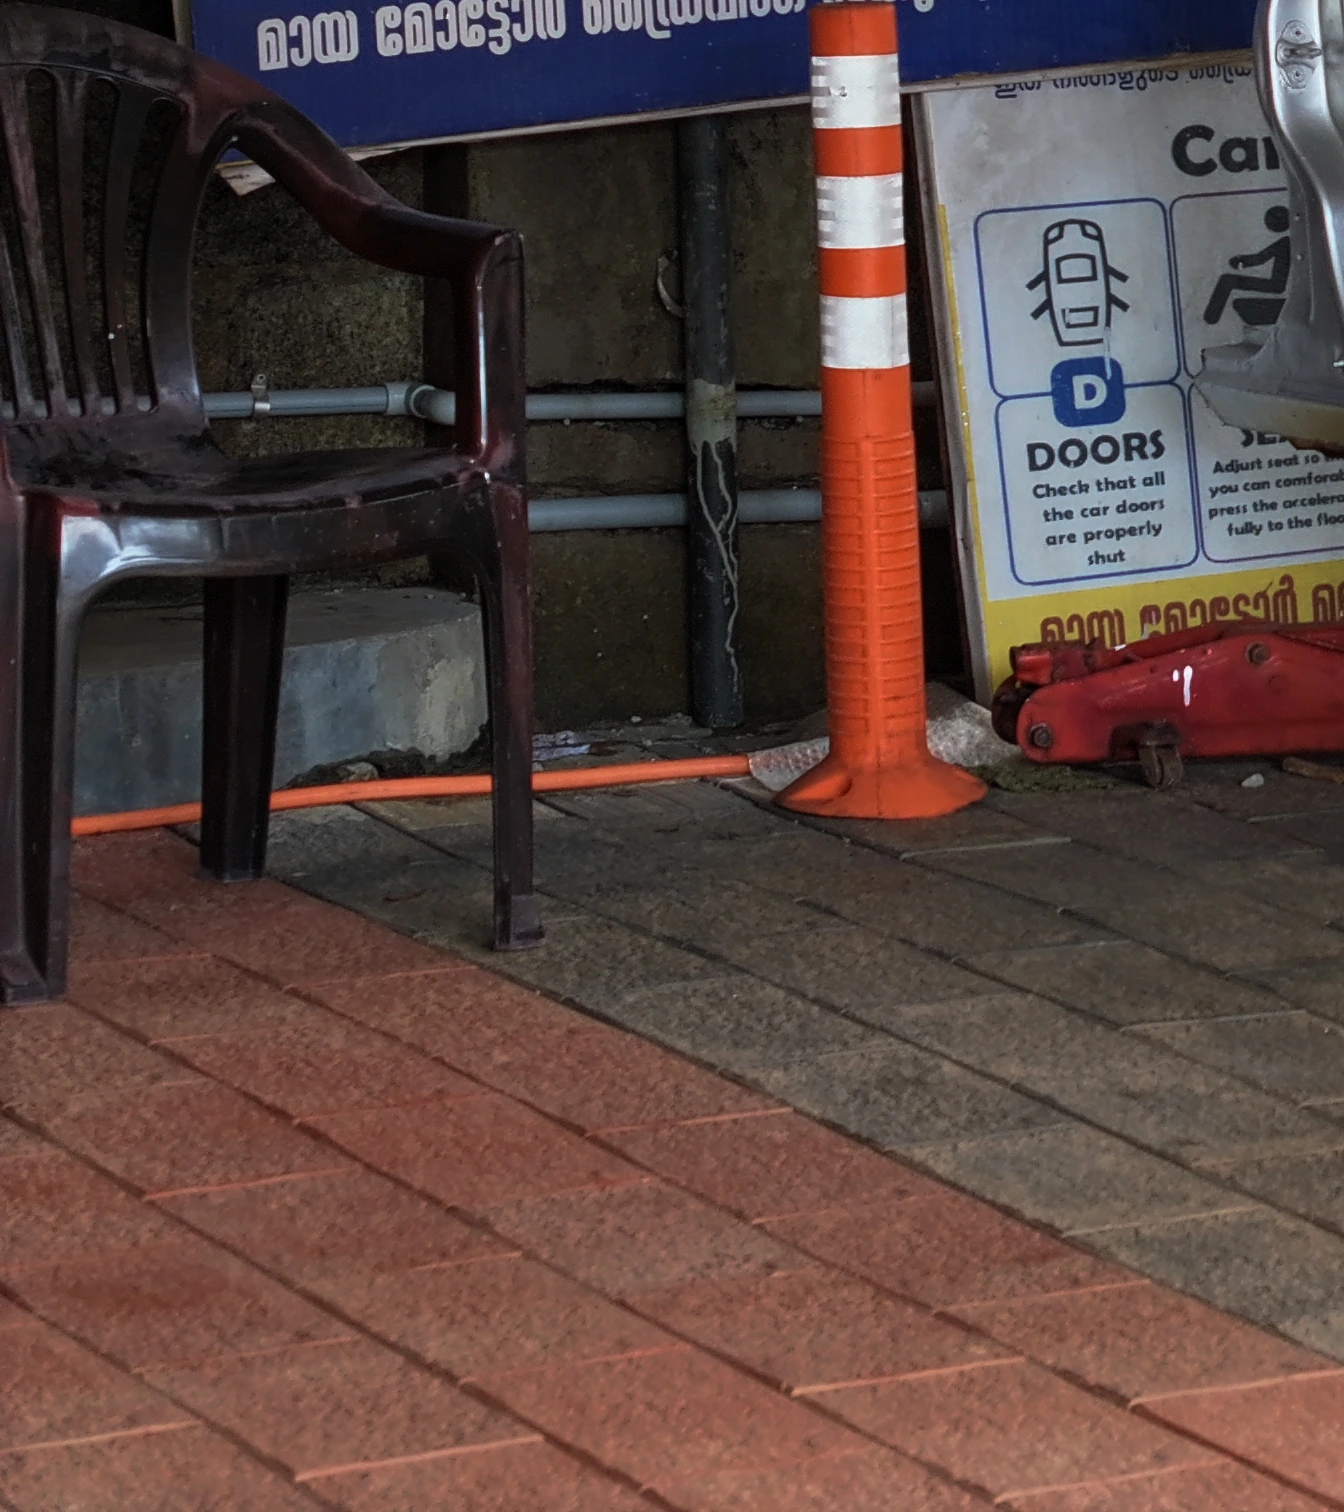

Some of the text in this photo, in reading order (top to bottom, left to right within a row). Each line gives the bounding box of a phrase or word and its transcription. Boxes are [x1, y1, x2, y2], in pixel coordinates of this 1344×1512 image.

[257, 8, 359, 71] മായ
[1072, 373, 1108, 410] D
[1026, 429, 1166, 473] DOORS
[1213, 458, 1263, 475] Adjust
[1267, 454, 1300, 469] seat
[1304, 453, 1321, 465] so
[1033, 472, 1166, 499] Check that all
[1208, 483, 1239, 499] you
[1243, 479, 1271, 492] can
[1043, 497, 1165, 523] the car doors
[1208, 503, 1248, 520] press
[1252, 498, 1278, 513] the
[1046, 521, 1164, 546] are properly
[1227, 521, 1263, 537] fully
[1268, 519, 1284, 533] to
[1287, 515, 1313, 530] the
[1087, 549, 1126, 566] shut
